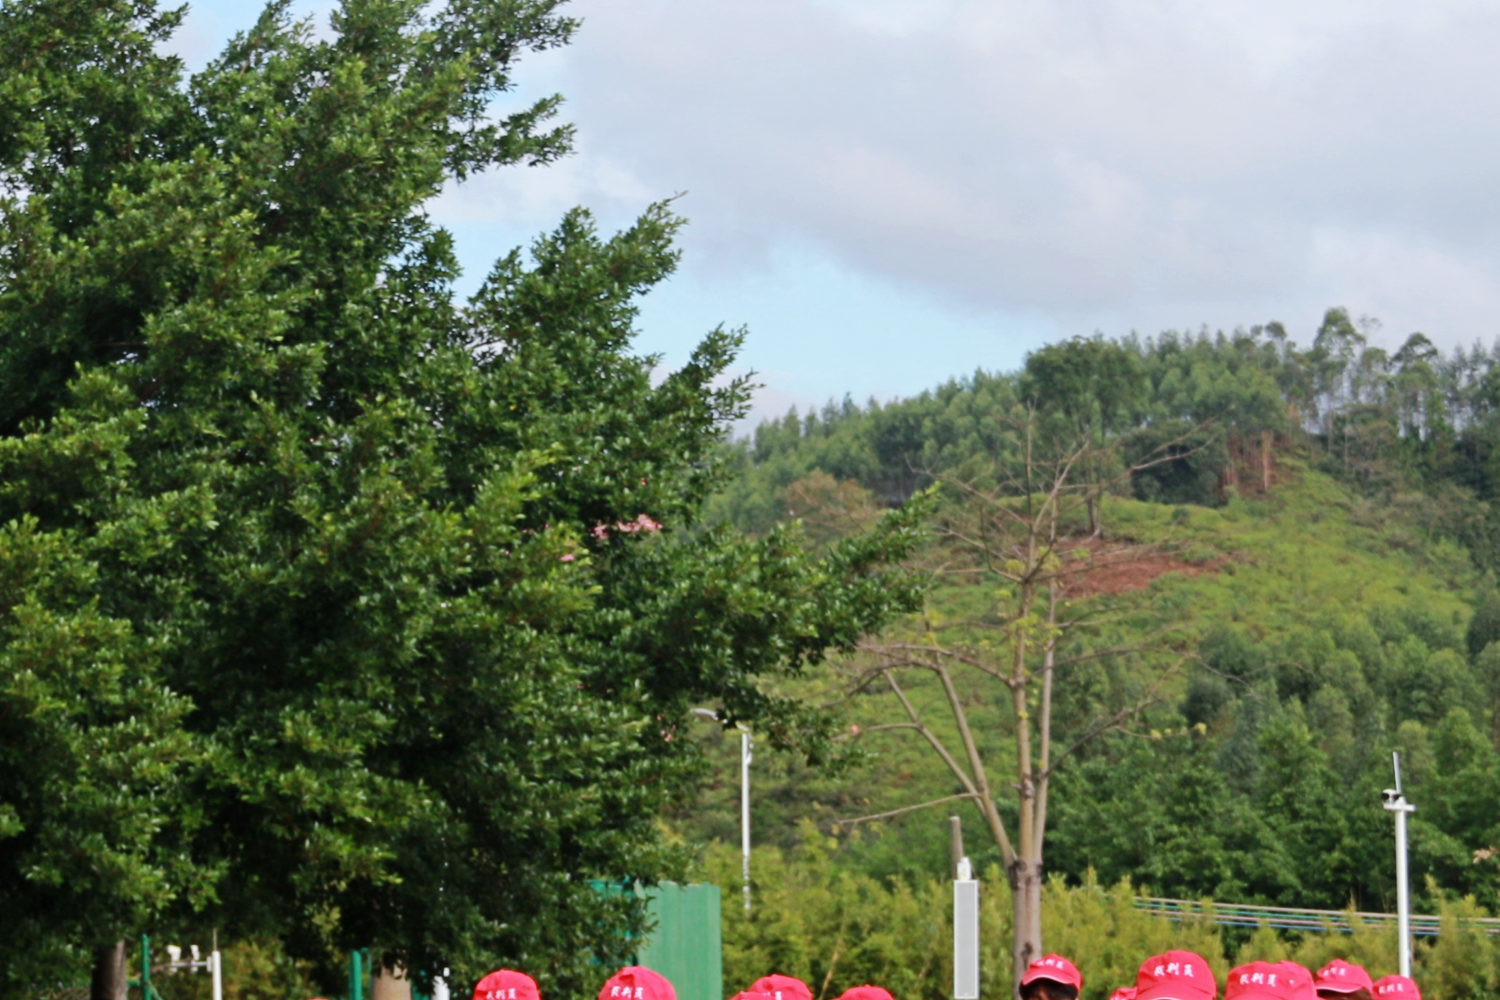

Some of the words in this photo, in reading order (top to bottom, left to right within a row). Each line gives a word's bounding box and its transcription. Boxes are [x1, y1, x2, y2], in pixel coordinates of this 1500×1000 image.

[1154, 962, 1193, 977] 裁判员
[1240, 972, 1276, 987] 裁判员
[611, 985, 643, 999] 裁判员
